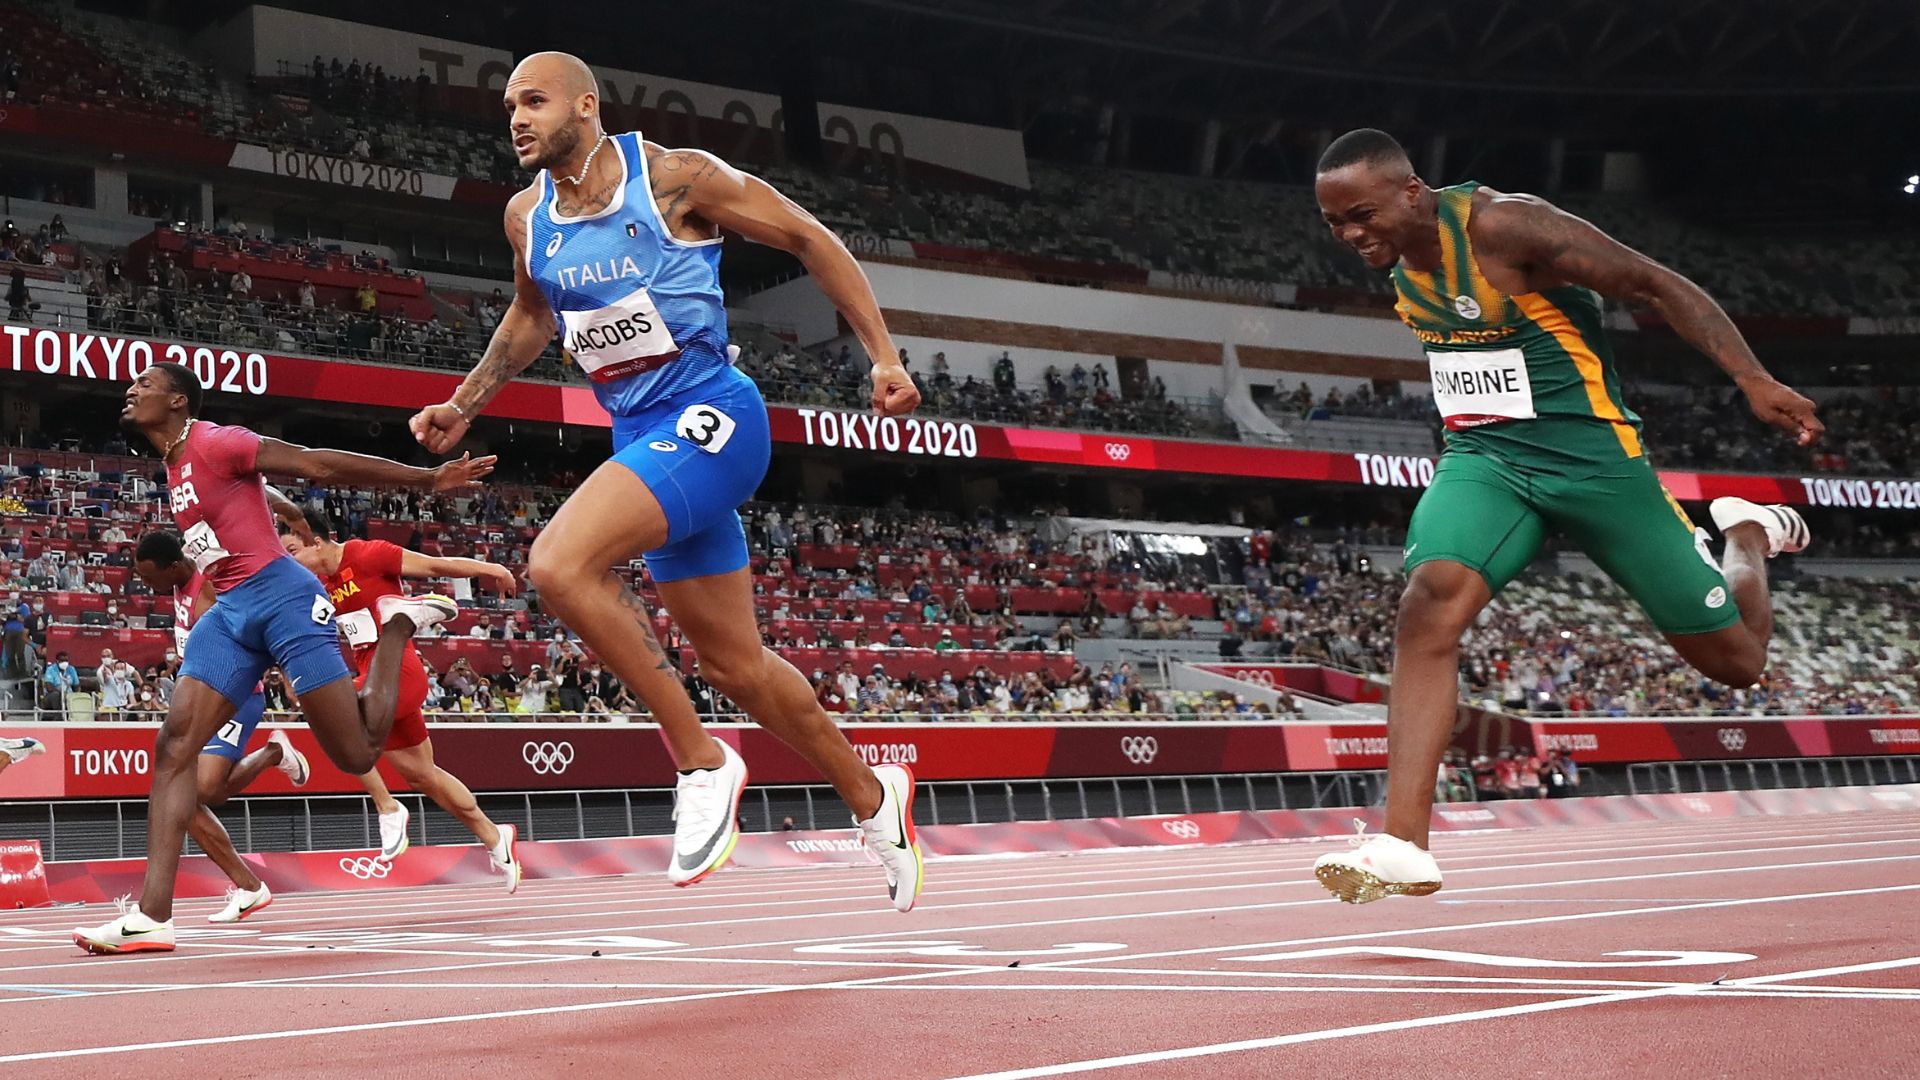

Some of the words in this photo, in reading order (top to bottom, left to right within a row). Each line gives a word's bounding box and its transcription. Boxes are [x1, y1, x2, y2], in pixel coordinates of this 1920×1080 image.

[420, 47, 699, 147] TOYO
[269, 147, 354, 184] TOKYO
[362, 163, 423, 197] 2020
[557, 256, 640, 290] ITALIA
[570, 312, 652, 353] JACOBS
[4, 325, 153, 381] TOKYO
[1434, 368, 1520, 395] SIMBINE
[685, 410, 721, 446] 3
[798, 409, 900, 452] TOKYO
[906, 419, 977, 458] 2020
[1354, 453, 1434, 488] TOKYO
[170, 481, 200, 514] USA
[1800, 478, 1872, 508] TOKYO
[328, 581, 361, 604] HINA
[344, 622, 358, 636] SU
[225, 721, 237, 738] 7
[70, 749, 149, 775] TOKYO
[880, 743, 917, 763] 2020
[786, 840, 835, 853] TOKYO
[836, 838, 862, 851] 202
[793, 940, 1128, 956] 3
[1218, 945, 1758, 968] 2
